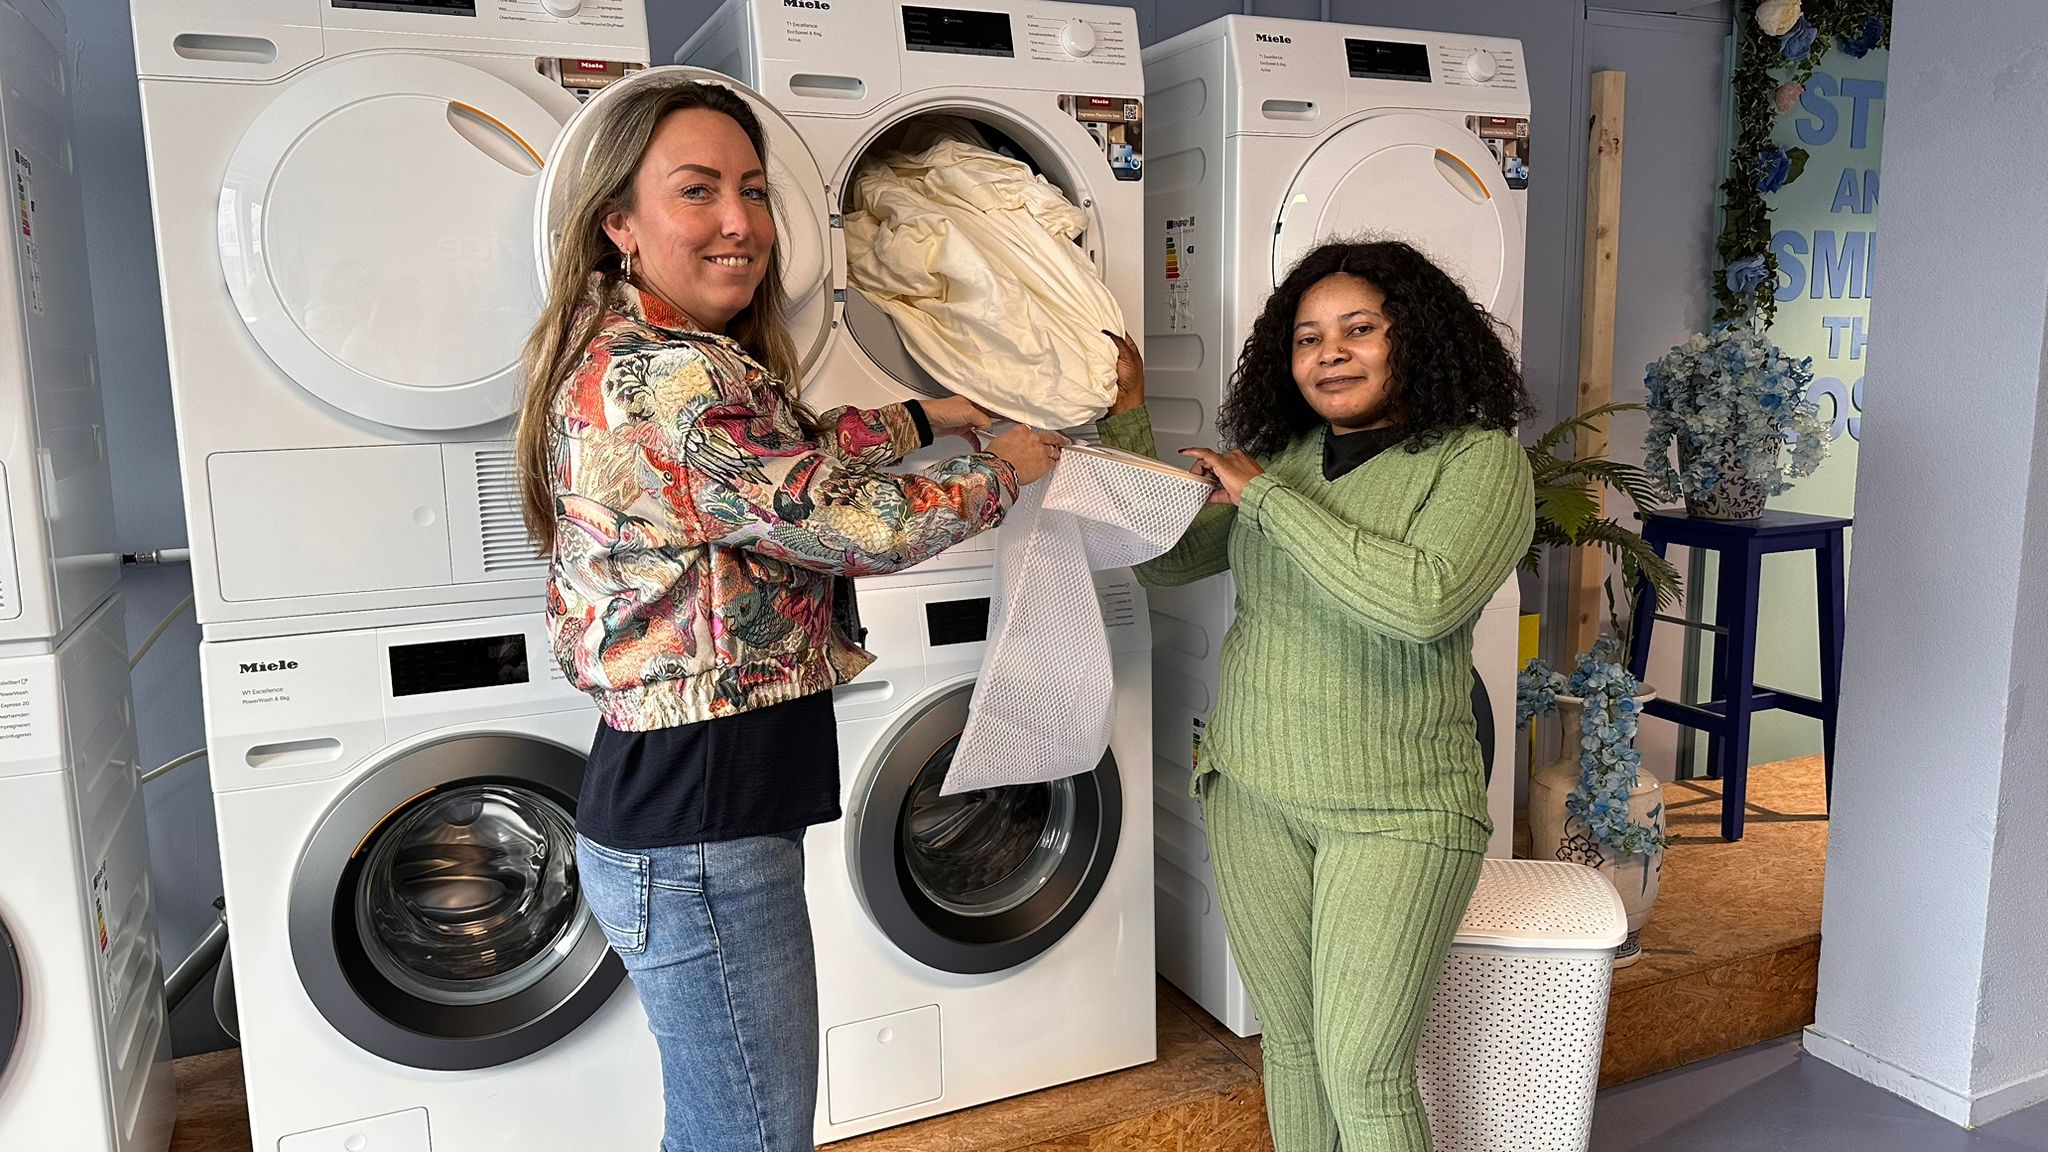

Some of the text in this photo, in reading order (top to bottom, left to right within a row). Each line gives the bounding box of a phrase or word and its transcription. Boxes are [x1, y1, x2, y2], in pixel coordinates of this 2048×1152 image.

[784, 0, 830, 10] Miele
[1256, 34, 1291, 44] Miele
[239, 660, 298, 673] Miele
